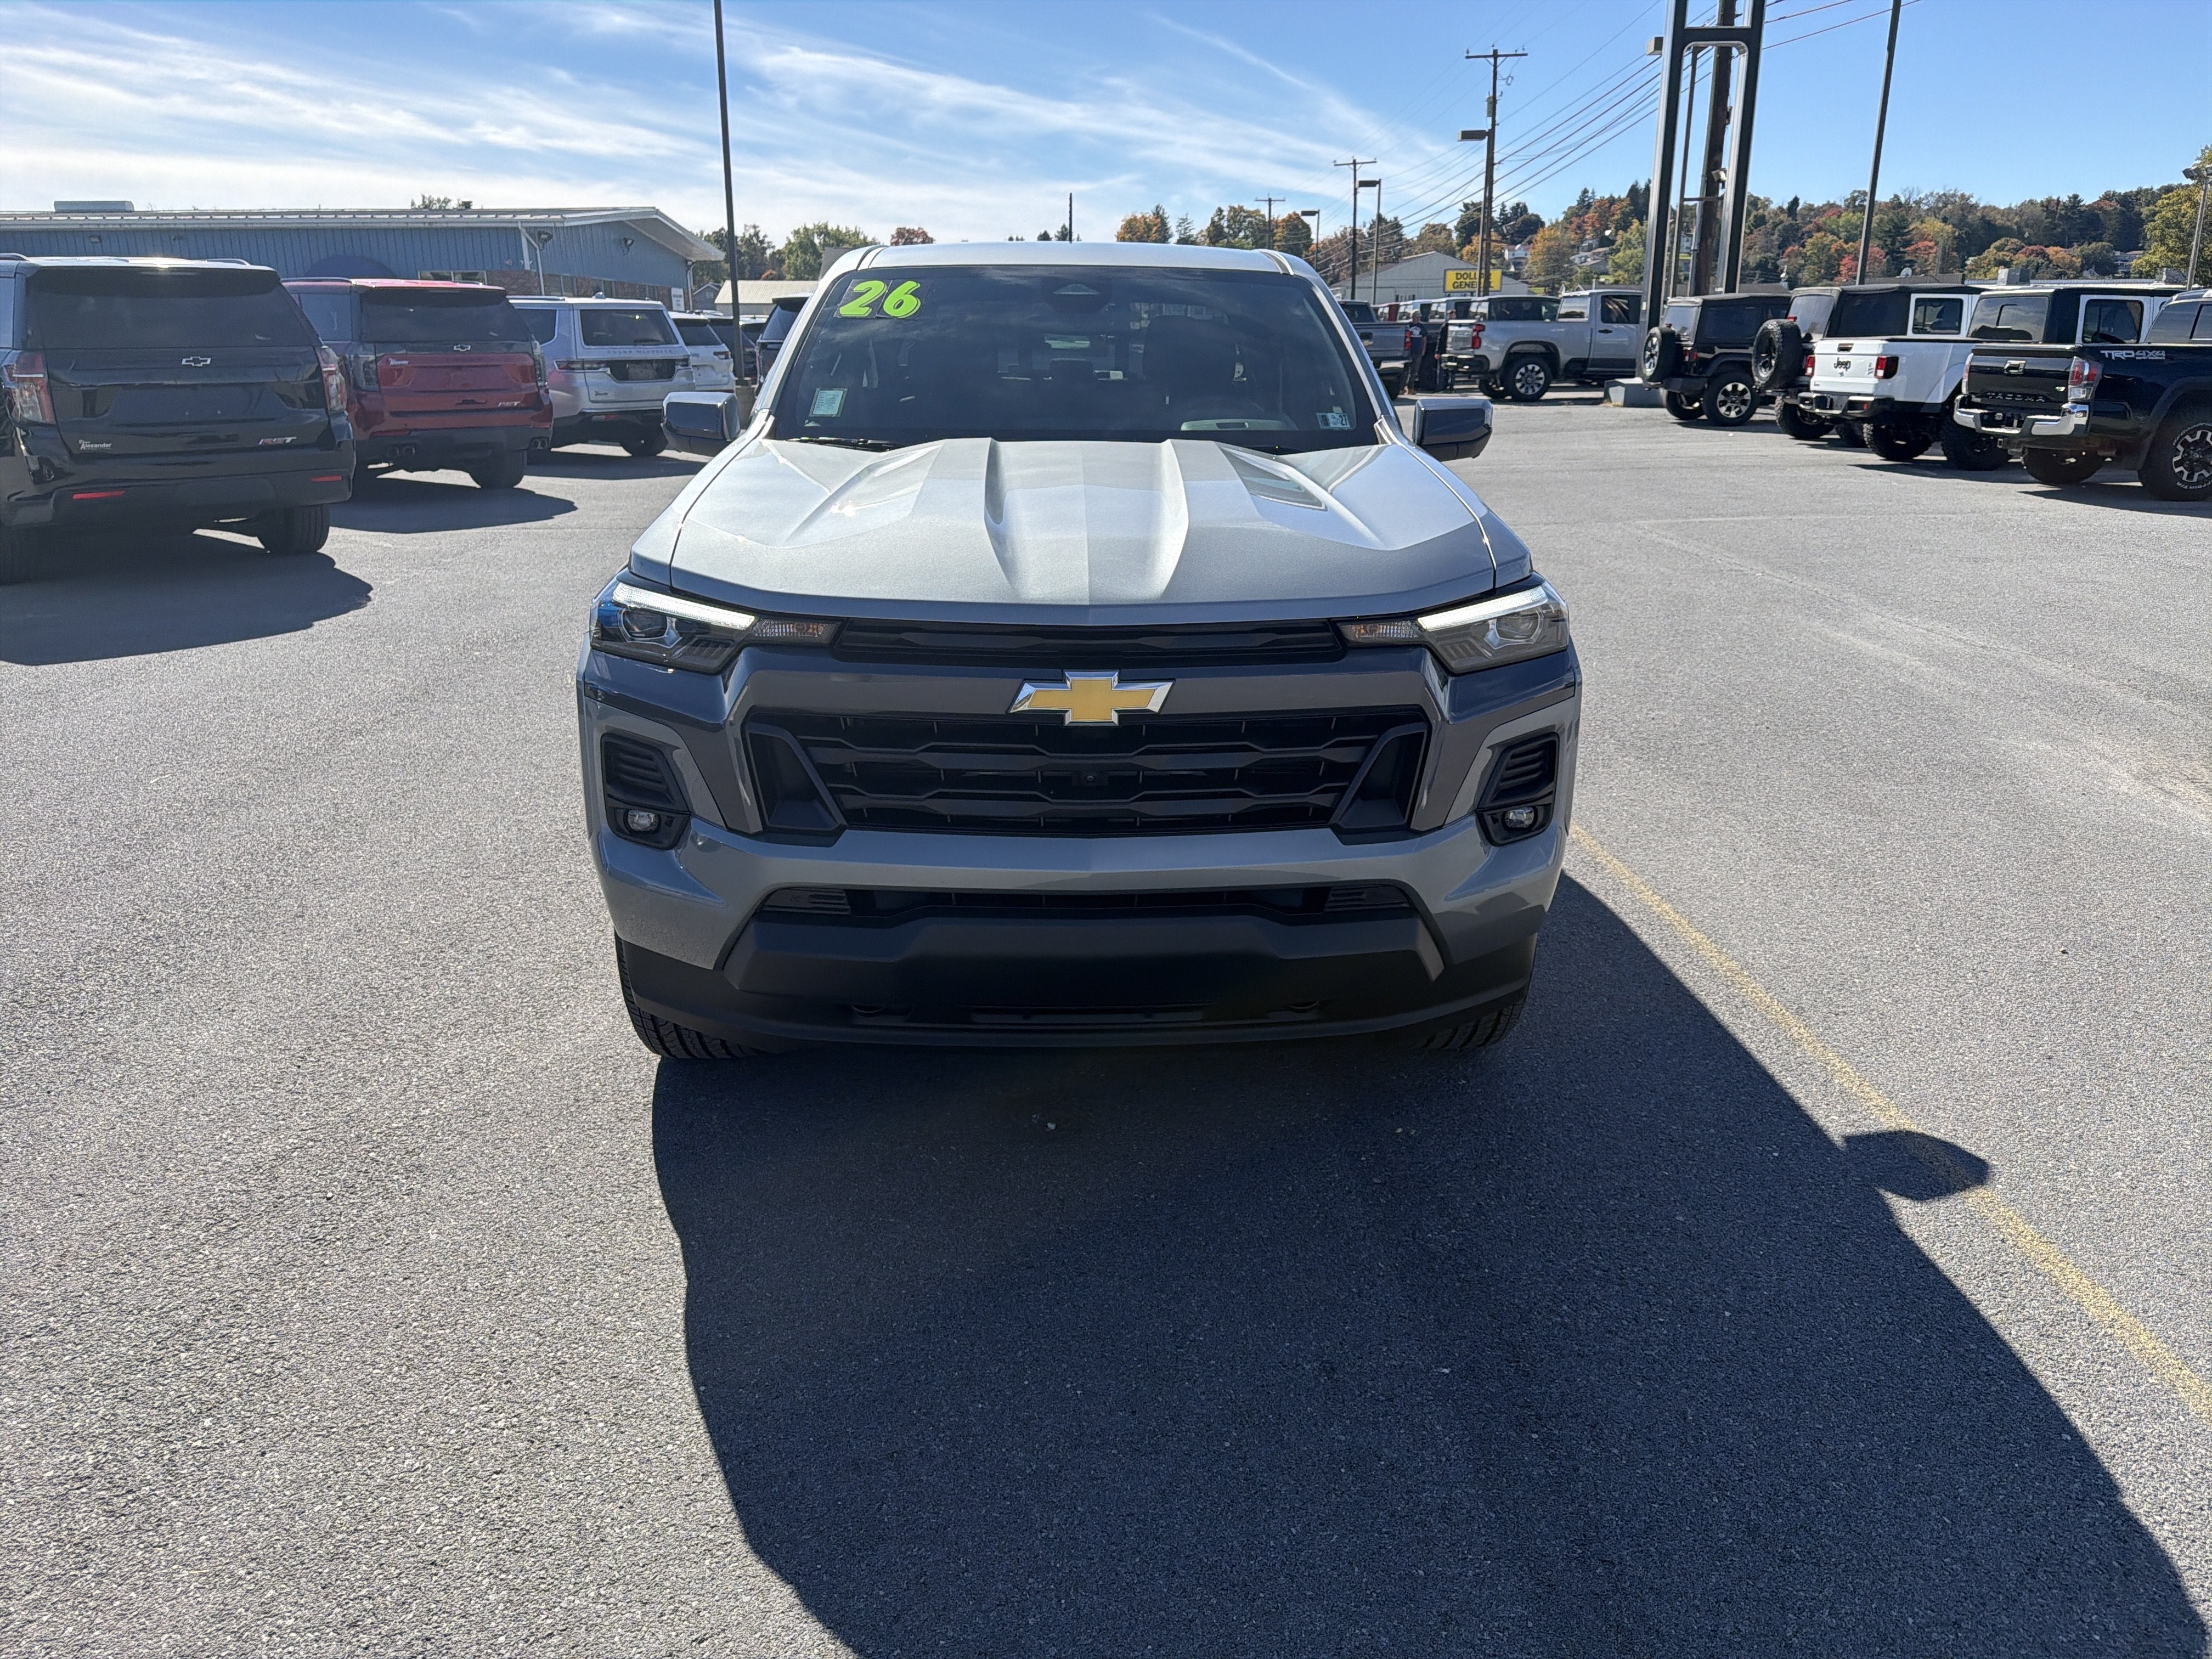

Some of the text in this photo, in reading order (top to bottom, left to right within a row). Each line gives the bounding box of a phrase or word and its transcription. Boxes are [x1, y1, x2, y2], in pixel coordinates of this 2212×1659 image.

[1455, 272, 1492, 280] DOLL
[839, 280, 921, 319] 26
[2100, 351, 2135, 360] TRD
[1833, 357, 1851, 371] Jeep
[1987, 392, 2045, 402] TACOMA
[1339, 415, 1347, 426] 27
